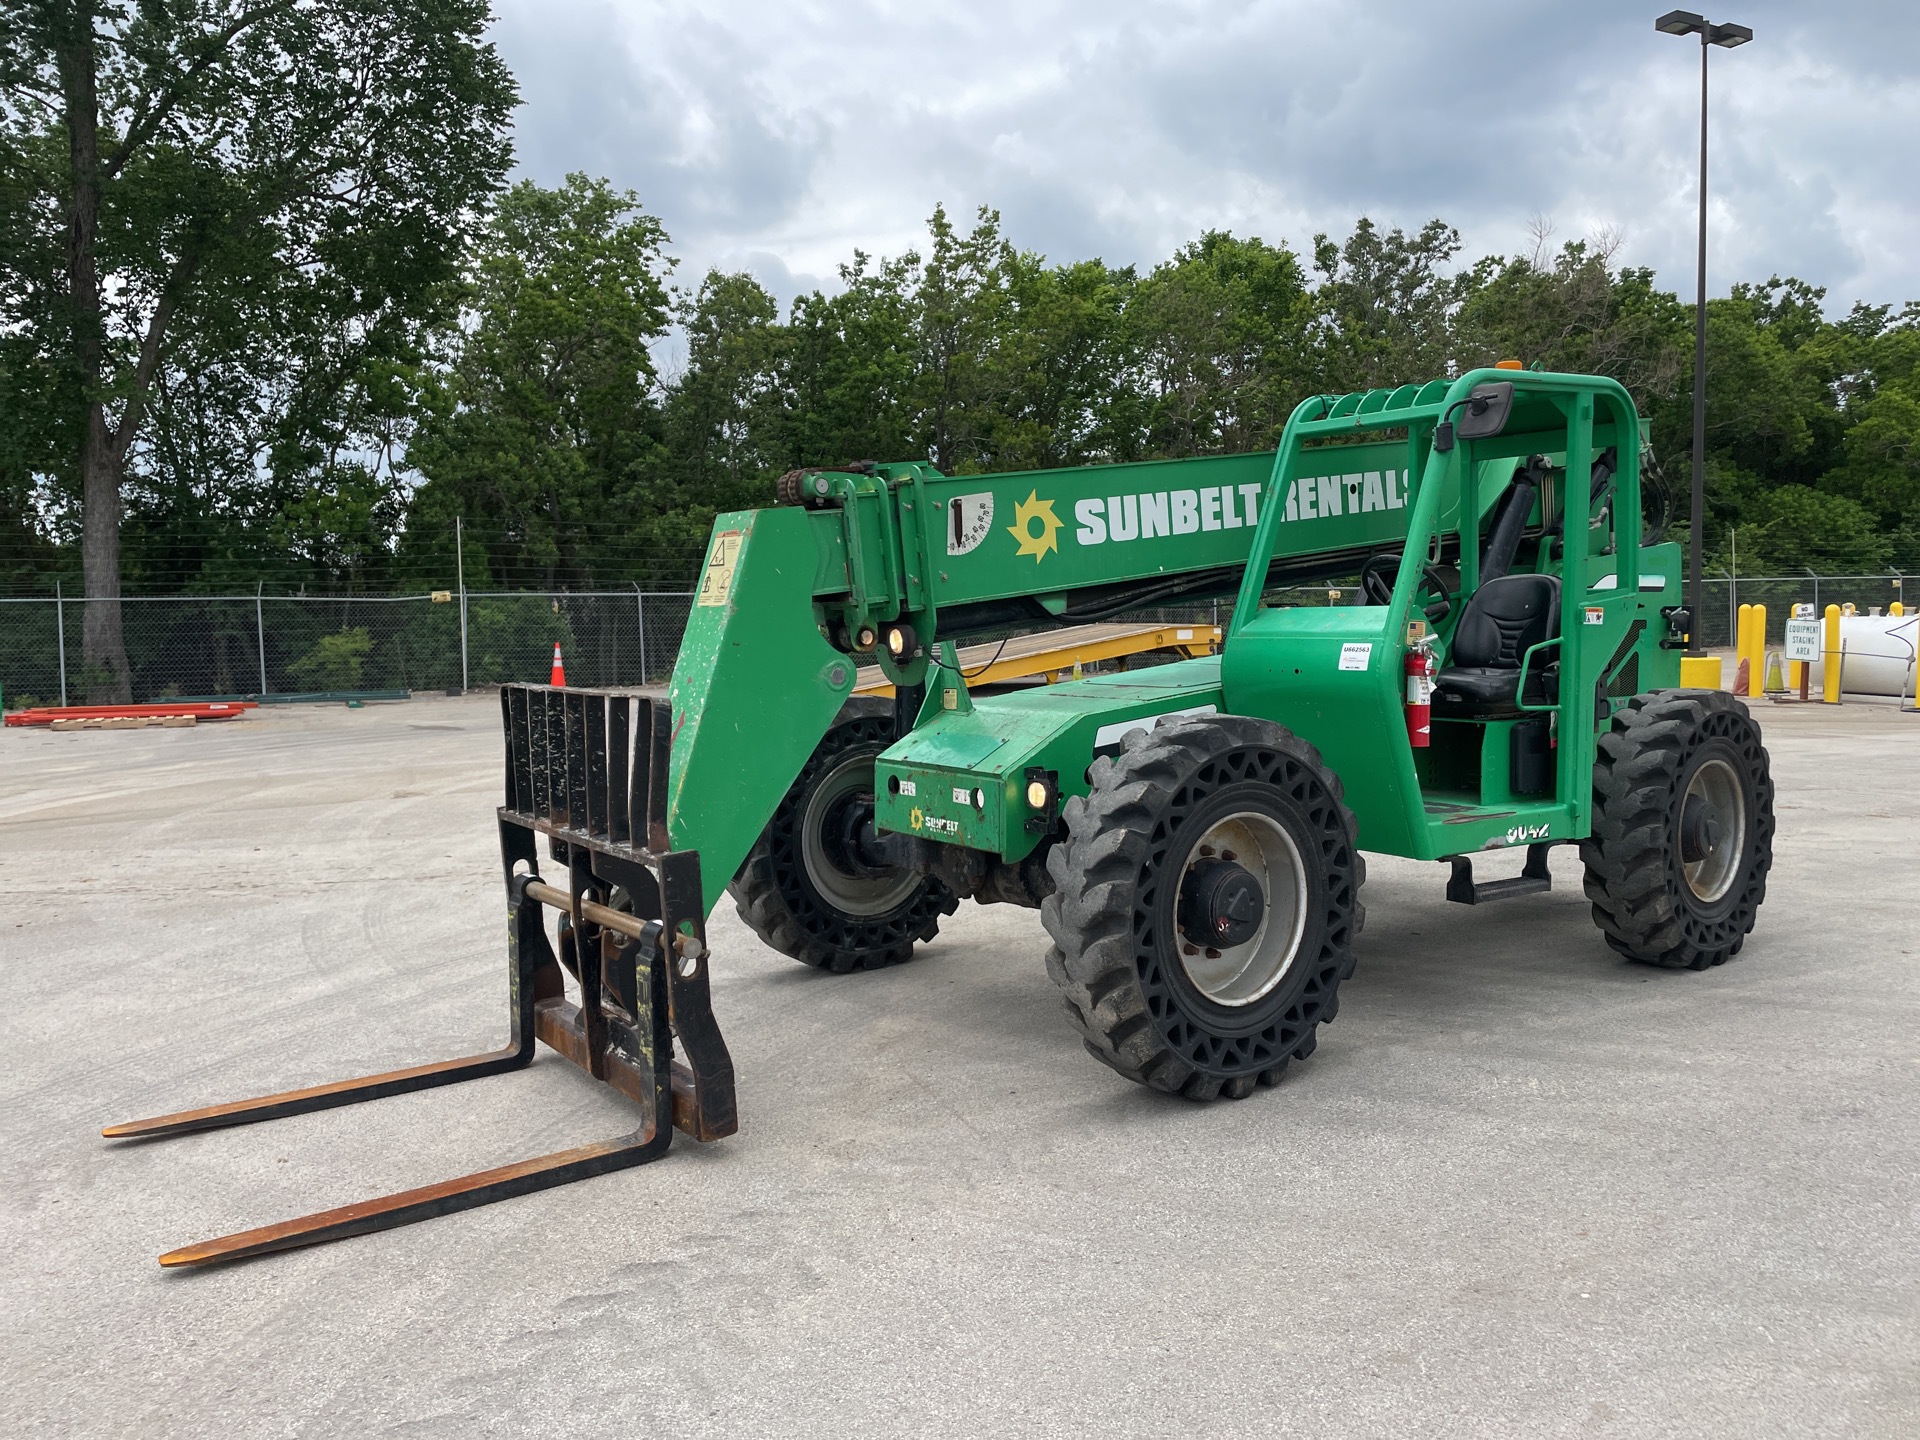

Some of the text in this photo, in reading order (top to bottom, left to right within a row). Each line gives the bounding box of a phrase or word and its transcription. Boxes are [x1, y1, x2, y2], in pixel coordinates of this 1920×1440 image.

[1074, 468, 1408, 546] SUNBELT RENTAL
[1788, 625, 1819, 634] EQUIPMENT
[1792, 635, 1815, 645] STAGING
[1795, 646, 1810, 656] AREA
